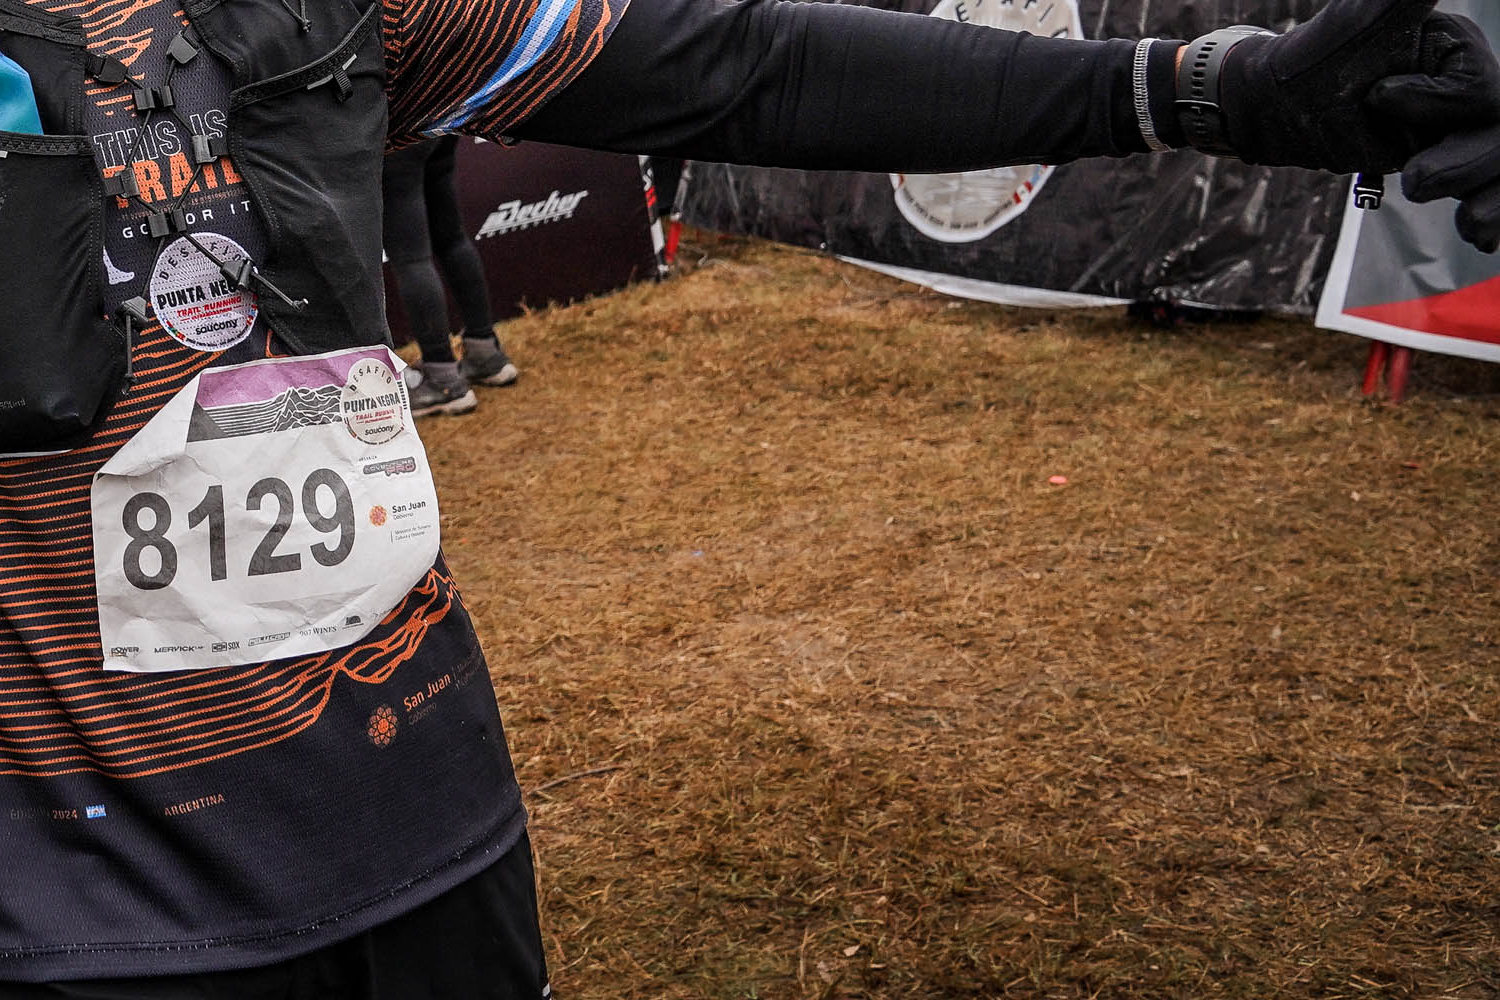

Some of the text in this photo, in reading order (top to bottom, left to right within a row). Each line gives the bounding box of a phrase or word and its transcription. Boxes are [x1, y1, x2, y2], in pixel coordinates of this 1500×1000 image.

[93, 109, 228, 169] THIS IS
[186, 209, 214, 225] OR
[230, 200, 250, 215] IT
[157, 285, 207, 310] PUNTA
[177, 307, 201, 317] TRAIL
[203, 296, 242, 311] RUNNING
[195, 319, 238, 335] saucony
[349, 365, 392, 392] DESAFIO
[343, 396, 377, 413] PUNTA
[356, 411, 373, 421] TRAIL
[364, 424, 395, 436] saucony
[392, 500, 427, 514] San Juan
[122, 468, 356, 590] 8129
[312, 625, 338, 636] WINES
[154, 645, 195, 653] MERVICK
[228, 641, 240, 650] SOX
[403, 673, 451, 712] San Juan
[164, 793, 226, 817] ARGENTINA
[52, 809, 78, 820] 2024
